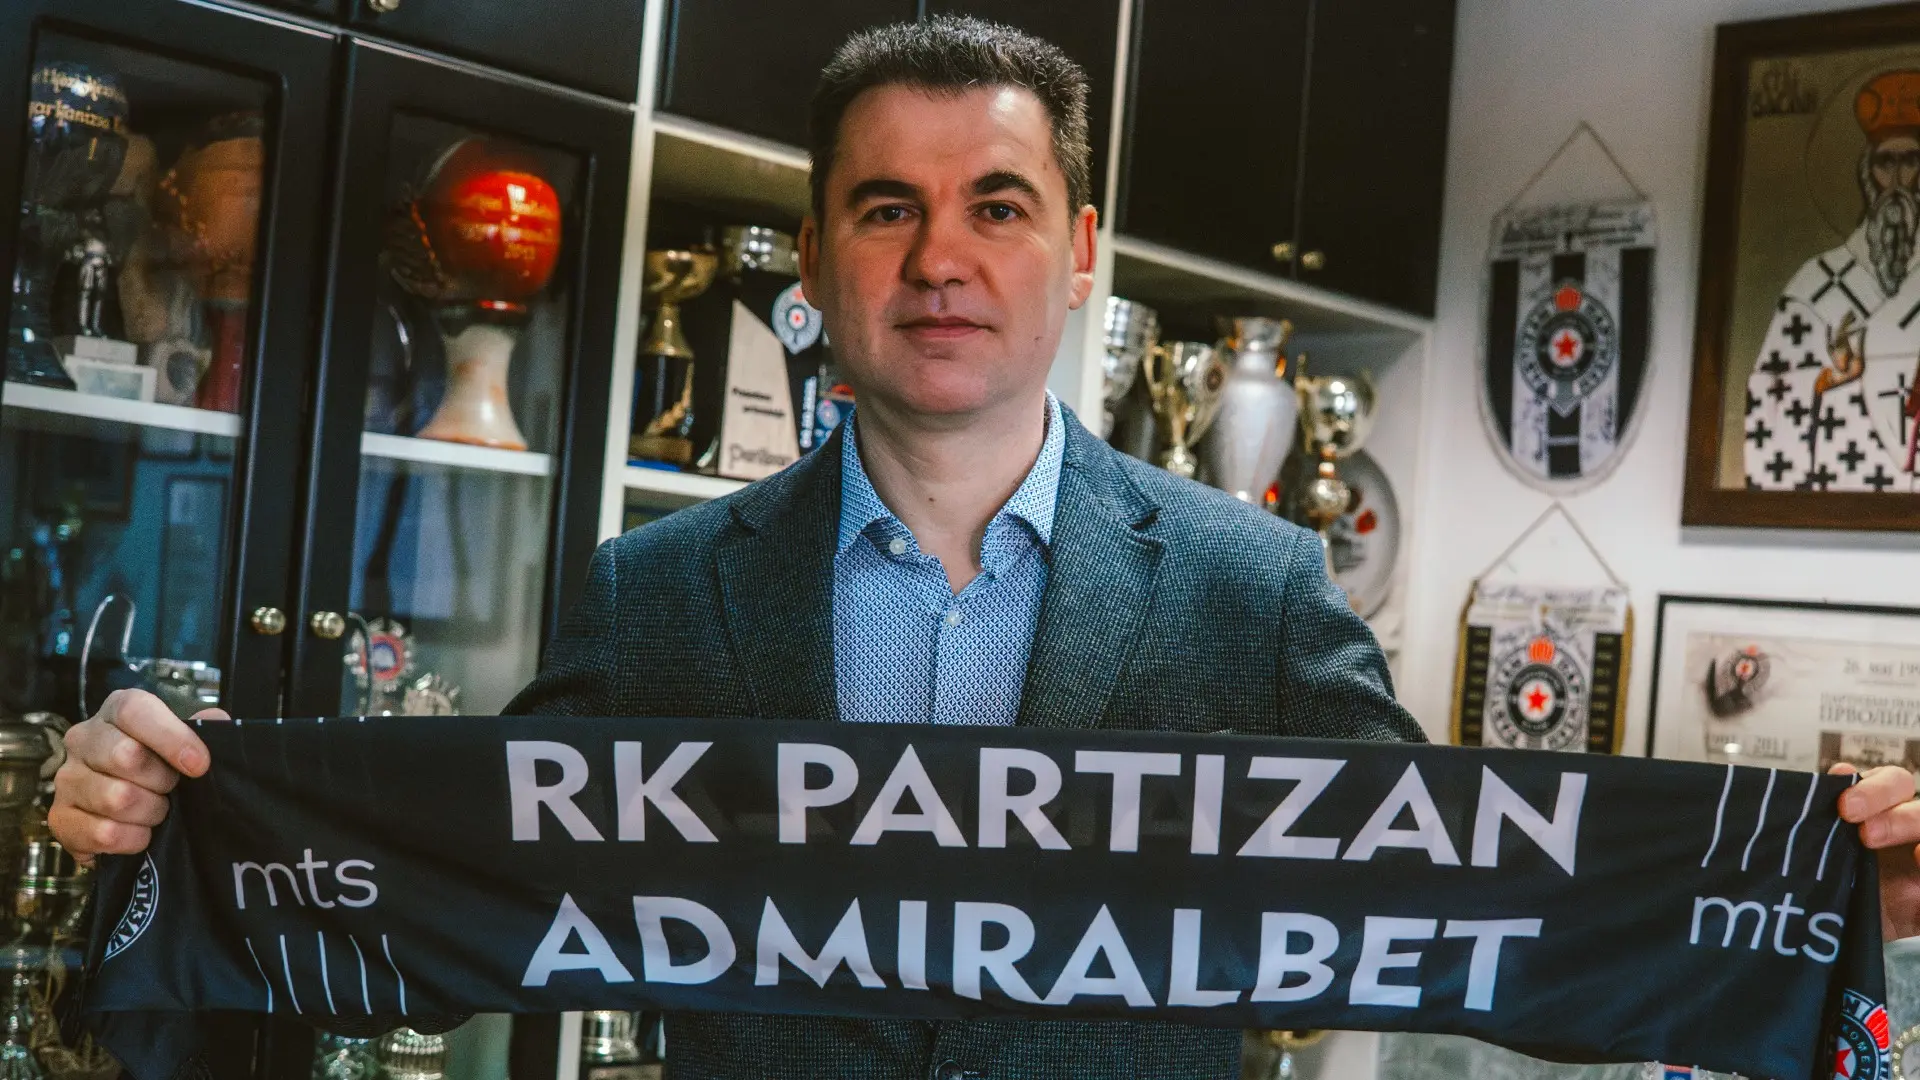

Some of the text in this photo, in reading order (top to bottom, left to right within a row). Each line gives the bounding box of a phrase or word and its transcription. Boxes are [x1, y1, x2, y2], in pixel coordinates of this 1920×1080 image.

[507, 741, 1587, 876] RK PARTIZAN
[232, 848, 379, 910] mts
[521, 892, 1543, 1011] ADMIRALBET
[1688, 892, 1844, 964] mts
